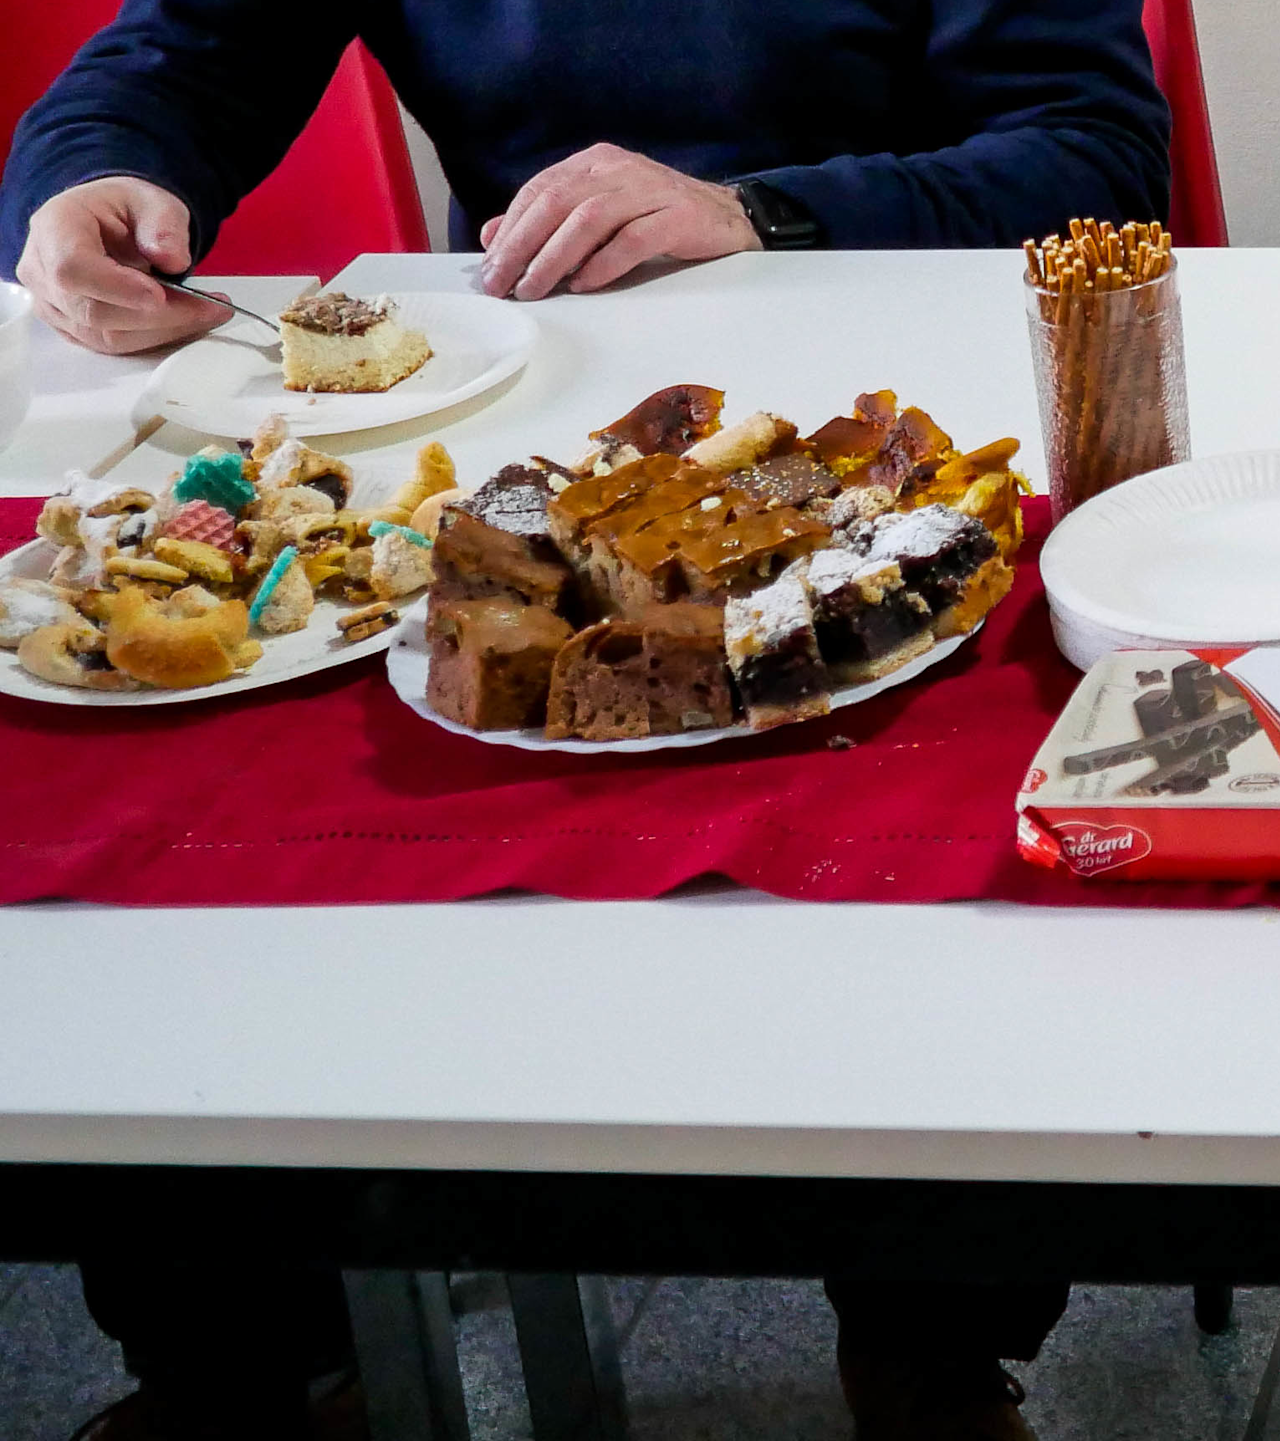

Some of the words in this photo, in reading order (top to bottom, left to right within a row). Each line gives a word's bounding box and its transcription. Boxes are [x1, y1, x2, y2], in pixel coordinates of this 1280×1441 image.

[1062, 831, 1134, 857] Gerard
[1080, 831, 1096, 844] dr
[1075, 855, 1094, 869] 30
